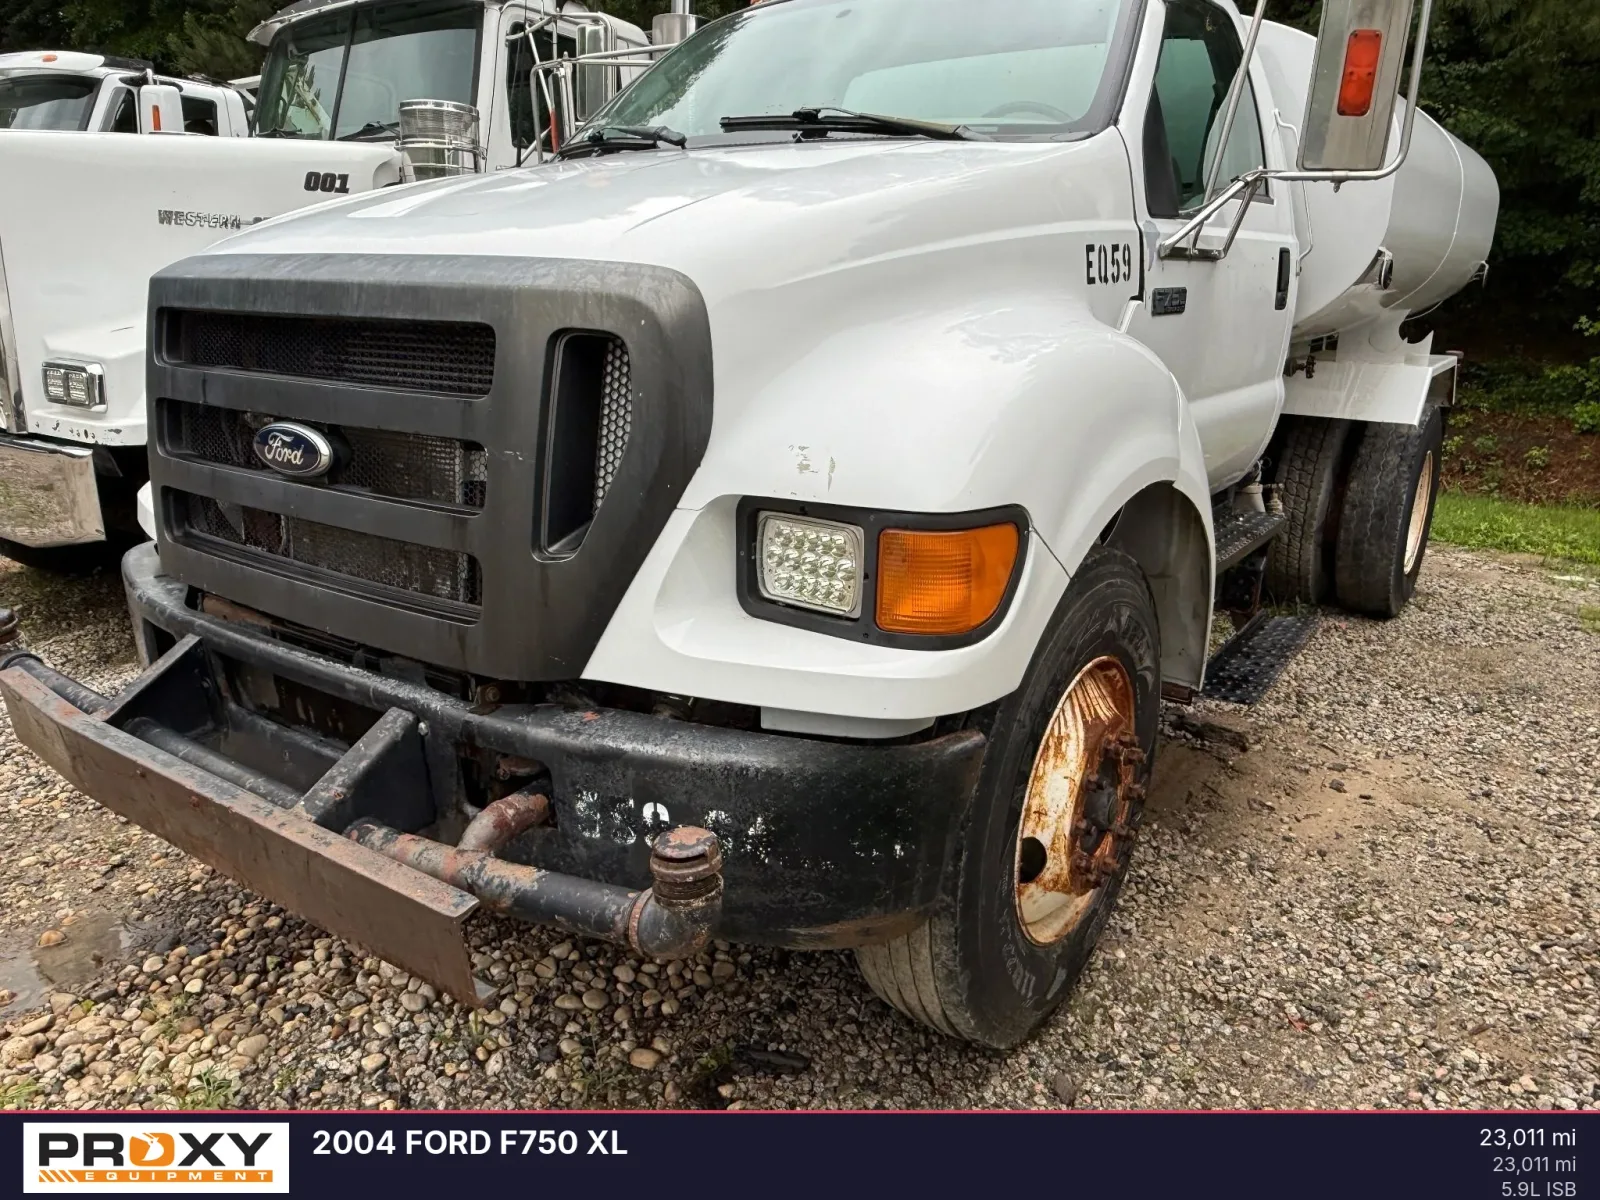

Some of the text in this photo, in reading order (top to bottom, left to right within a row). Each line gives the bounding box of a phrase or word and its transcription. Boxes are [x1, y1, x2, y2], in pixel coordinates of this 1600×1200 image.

[304, 171, 350, 194] 001
[158, 209, 241, 230] WESTERN
[1085, 243, 1131, 285] EQ59
[264, 431, 305, 465] Ford
